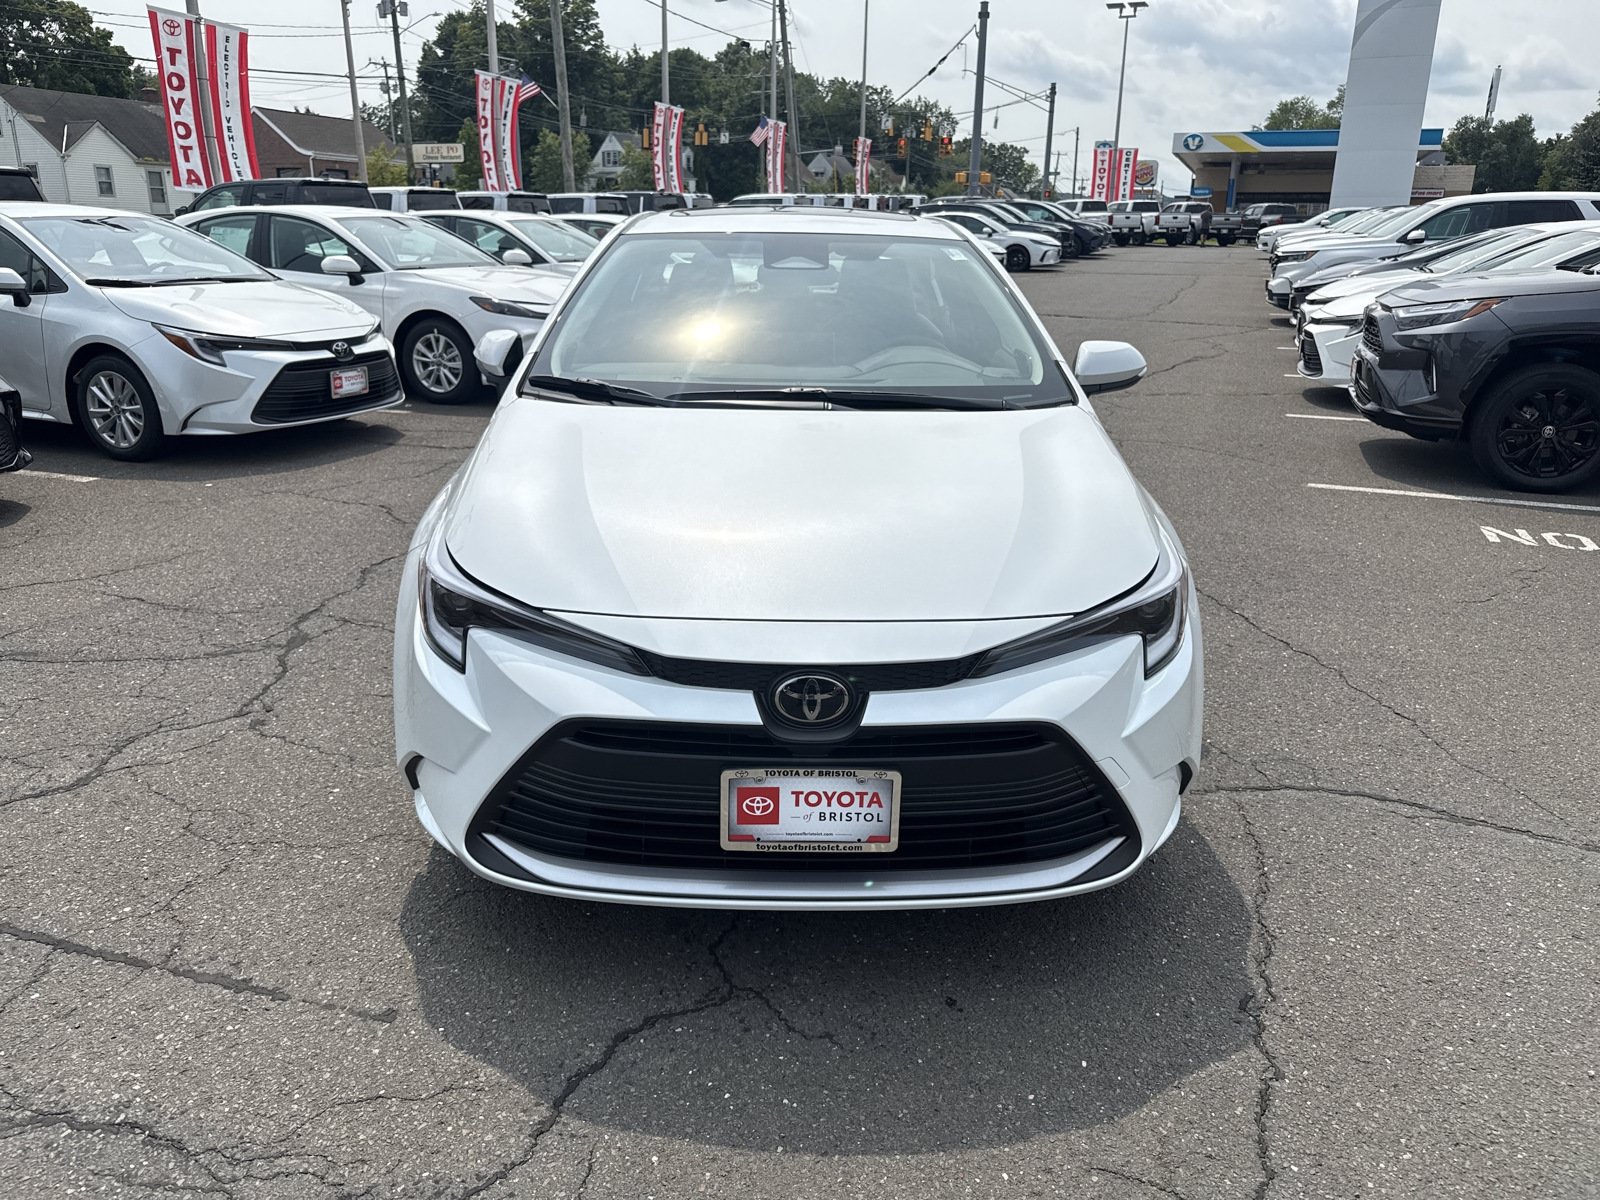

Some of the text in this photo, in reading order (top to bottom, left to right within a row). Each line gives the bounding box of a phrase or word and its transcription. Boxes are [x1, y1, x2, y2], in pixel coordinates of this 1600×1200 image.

[166, 47, 203, 186] TOYOTA
[1097, 159, 1106, 200] TOYOT
[1121, 151, 1132, 199] CERTIFIE
[764, 769, 801, 777] TOYOTA
[818, 770, 858, 778] BRISTOL
[790, 790, 884, 809] TOYOTA
[803, 812, 884, 823] of BRISTOL
[756, 843, 863, 852] toyotaofbristolct.com
